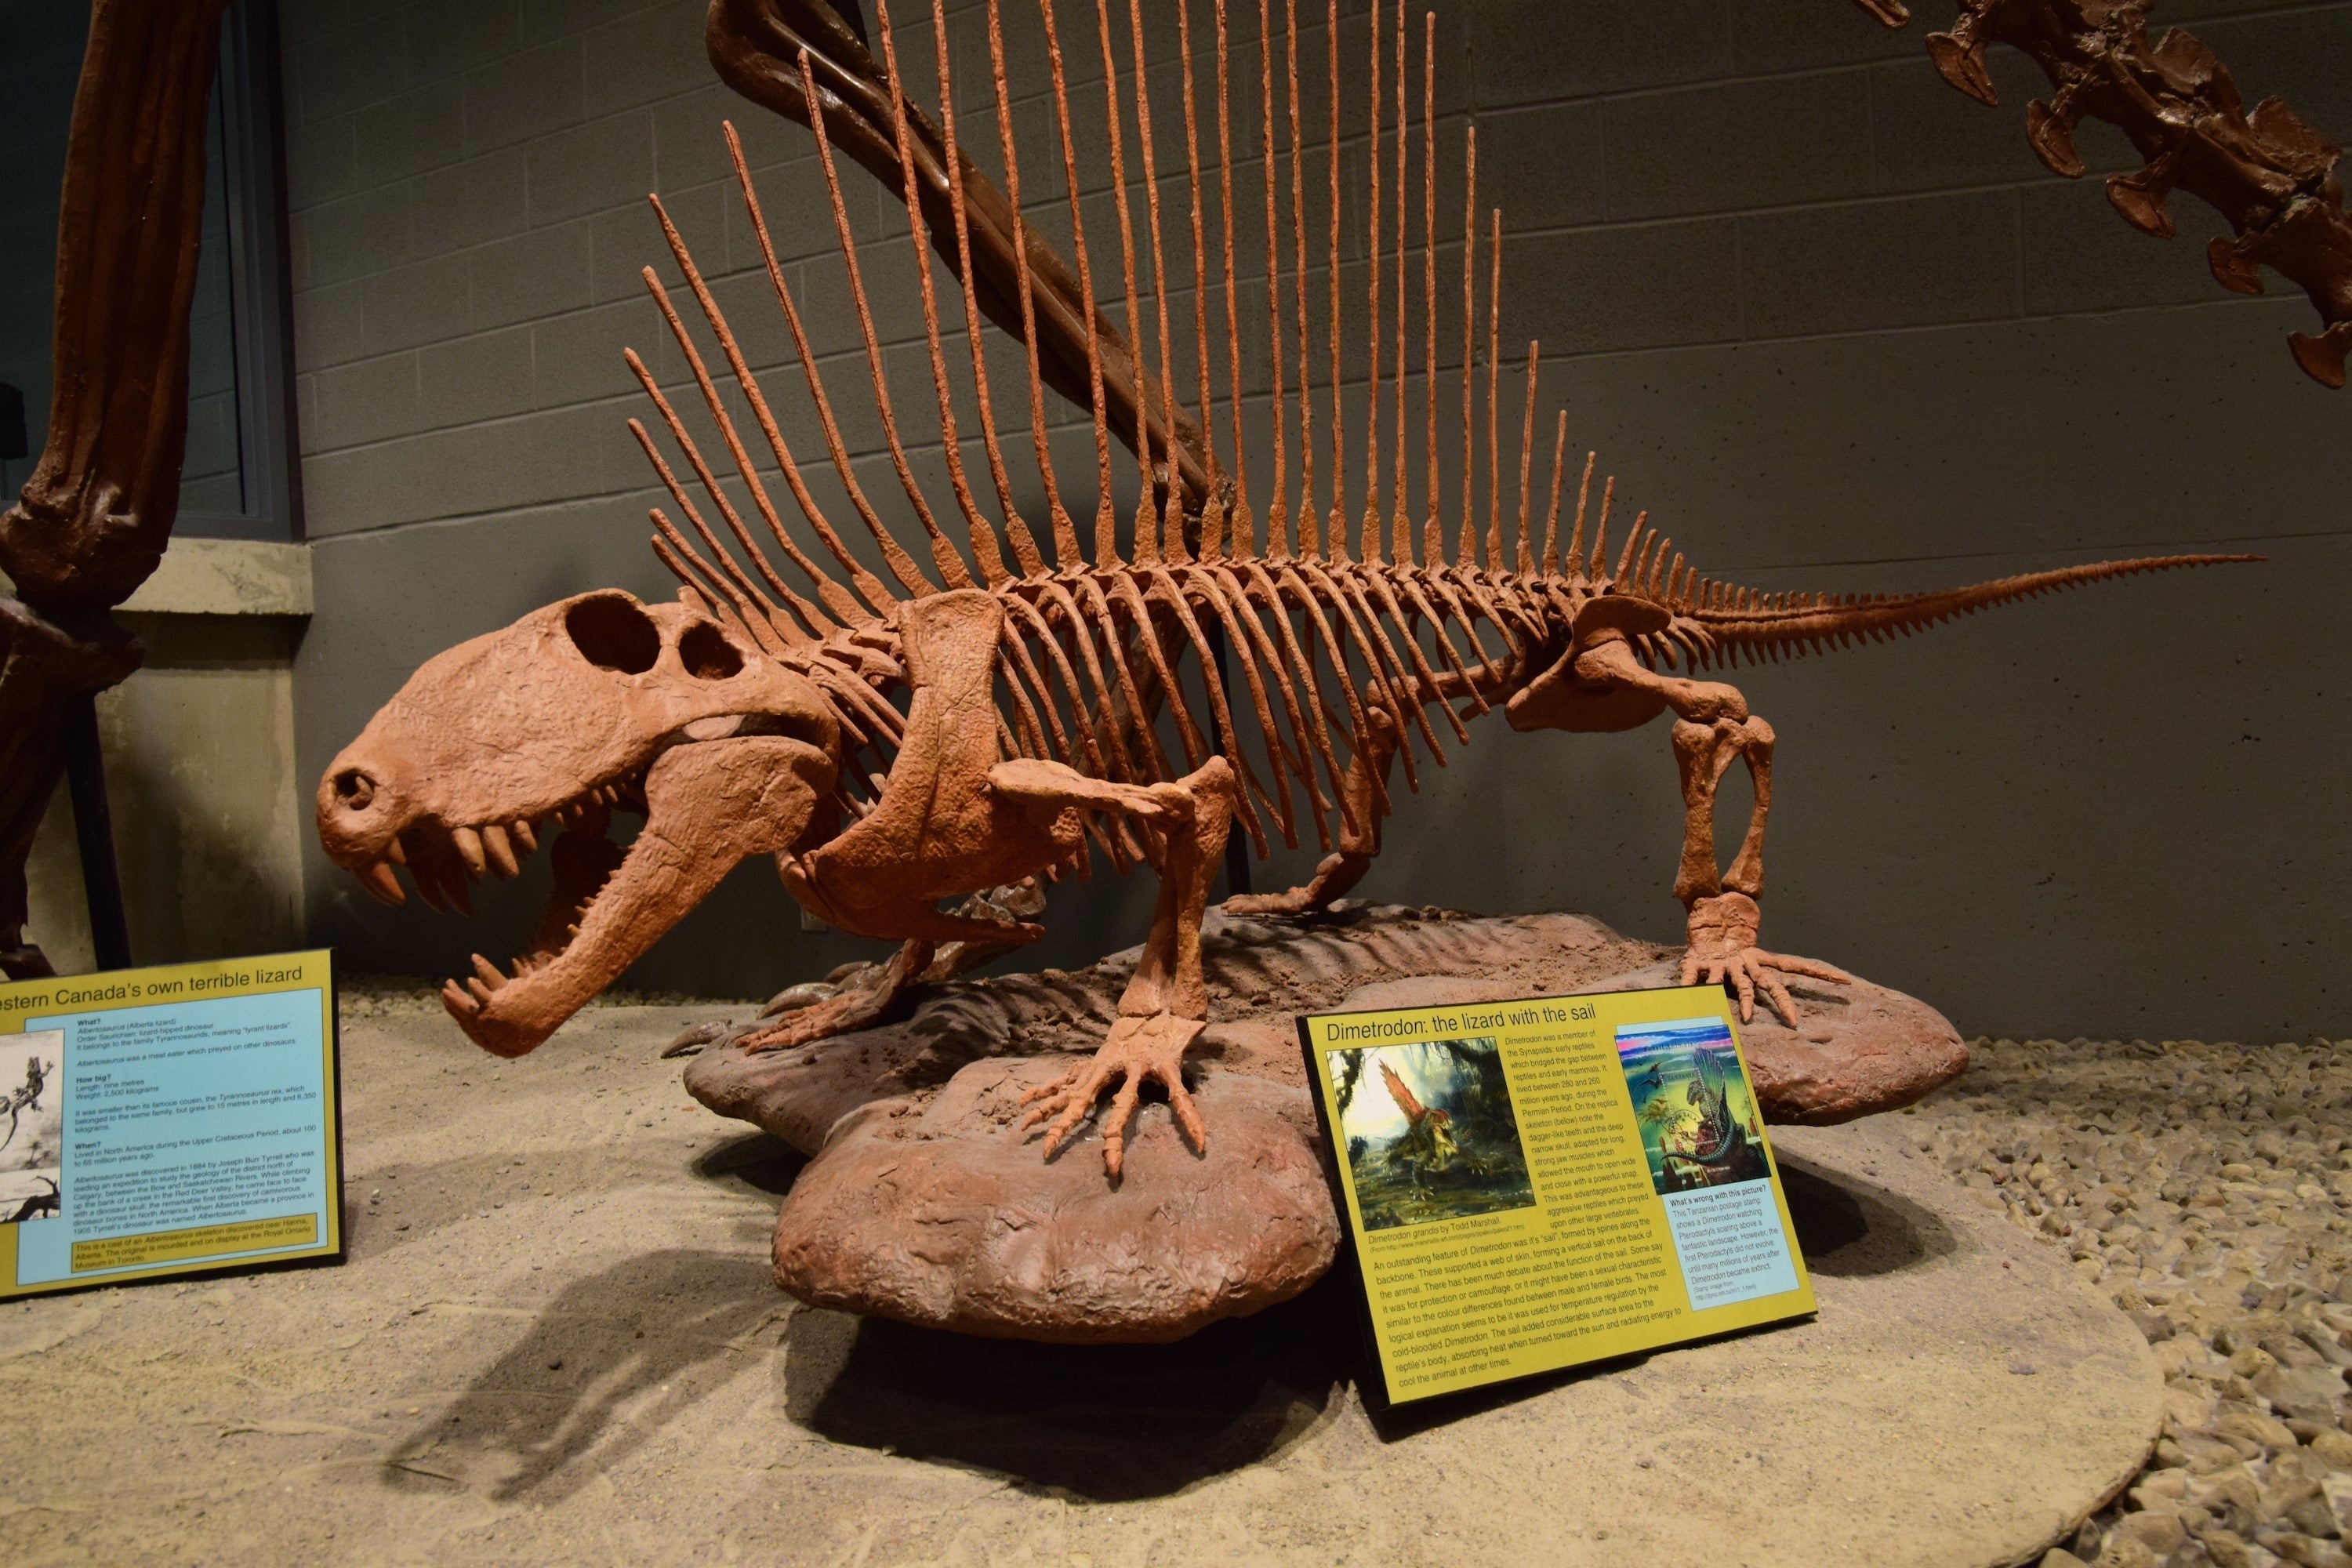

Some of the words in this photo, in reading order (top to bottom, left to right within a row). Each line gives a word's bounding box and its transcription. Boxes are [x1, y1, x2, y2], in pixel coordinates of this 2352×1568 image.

[0, 995, 48, 1010] stern
[56, 983, 140, 1004] Canada's
[147, 981, 183, 995] own
[189, 972, 249, 990] terrible
[256, 965, 301, 984] lizard
[77, 1018, 100, 1026] What?
[1327, 1018, 1428, 1040] Dimetrodon:
[1432, 1015, 1457, 1032] the
[1461, 1011, 1504, 1029] lizard
[1508, 1008, 1539, 1025] with
[1542, 1007, 1566, 1022] the
[1571, 1003, 1595, 1020] sail
[1505, 1035, 1541, 1045] Dimetrodon
[1563, 1031, 1588, 1040] member
[1519, 1046, 1554, 1057] Synapsids:
[1555, 1044, 1570, 1053] early
[1572, 1042, 1595, 1052] reptiles
[1530, 1057, 1555, 1067] bridged
[1567, 1056, 1579, 1065] gap
[1513, 1073, 1537, 1082] reptiles
[1552, 1069, 1567, 1077] early
[1568, 1065, 1600, 1075] mammals.
[1515, 1084, 1532, 1093] lived
[1560, 1079, 1573, 1087] 280
[1588, 1076, 1600, 1085] 260
[1541, 1093, 1559, 1104] years
[1560, 1090, 1575, 1102] ago,
[1576, 1090, 1595, 1098] during
[1522, 1108, 1549, 1117] Permian
[1550, 1104, 1573, 1113] Period.
[1597, 1098, 1617, 1109] replica
[1525, 1120, 1552, 1129] skeleton
[1554, 1116, 1577, 1127] (below)
[1593, 1112, 1604, 1121] the
[74, 1141, 101, 1150] When?
[1669, 1198, 1692, 1207] What's
[1741, 1185, 1766, 1196] picture?
[1672, 1208, 1686, 1218] This
[1686, 1204, 1719, 1215] Tanzanian
[1719, 1200, 1743, 1212] postage
[1676, 1220, 1696, 1229] shows
[1702, 1213, 1736, 1225] Dimetrodon
[1736, 1208, 1762, 1218] watching
[1368, 1232, 1410, 1244] Dimetrodon
[1413, 1226, 1439, 1240] grandis
[1439, 1225, 1449, 1234] by
[1450, 1221, 1469, 1231] Todd
[1679, 1227, 1715, 1240] Pterodactyls
[1716, 1223, 1739, 1233] soaring
[1738, 1221, 1757, 1229] above
[1681, 1241, 1707, 1251] fantastic
[1708, 1236, 1740, 1246] landscape.
[1740, 1229, 1768, 1241] However,
[1386, 1255, 1431, 1269] outstanding
[1432, 1250, 1458, 1261] feature
[1460, 1247, 1468, 1256] of
[1470, 1242, 1512, 1254] Dimetrodon
[1529, 1236, 1539, 1244] it's
[1561, 1228, 1585, 1239] formed
[1586, 1227, 1595, 1236] by
[1596, 1224, 1618, 1234] spines
[1620, 1220, 1639, 1229] along
[1697, 1247, 1733, 1260] Pterodactyls
[1734, 1243, 1744, 1253] did
[1744, 1241, 1755, 1250] not
[1755, 1240, 1773, 1248] evolve
[1376, 1272, 1417, 1285] backbone.
[1417, 1268, 1442, 1277] These
[1443, 1259, 1481, 1273] supported
[1489, 1256, 1504, 1265] web
[1506, 1254, 1513, 1262] of
[1515, 1252, 1532, 1261] skin,
[1533, 1247, 1560, 1258] forming
[1567, 1240, 1592, 1251] vertical
[1593, 1238, 1605, 1247] sail
[1628, 1231, 1645, 1241] back
[1646, 1229, 1652, 1238] of
[1688, 1264, 1700, 1273] until
[1719, 1258, 1741, 1267] millions
[1742, 1254, 1748, 1263] of
[1749, 1253, 1766, 1263] years
[1766, 1250, 1780, 1258] after
[1691, 1272, 1726, 1284] Dimetrodon
[1726, 1267, 1750, 1277] became
[1751, 1262, 1772, 1272] extinct.
[1399, 1375, 1415, 1387] cool
[1417, 1374, 1430, 1384] the
[1432, 1367, 1457, 1381] animal
[1459, 1366, 1467, 1374] at
[1468, 1363, 1487, 1373] other
[1489, 1358, 1512, 1368] times.
